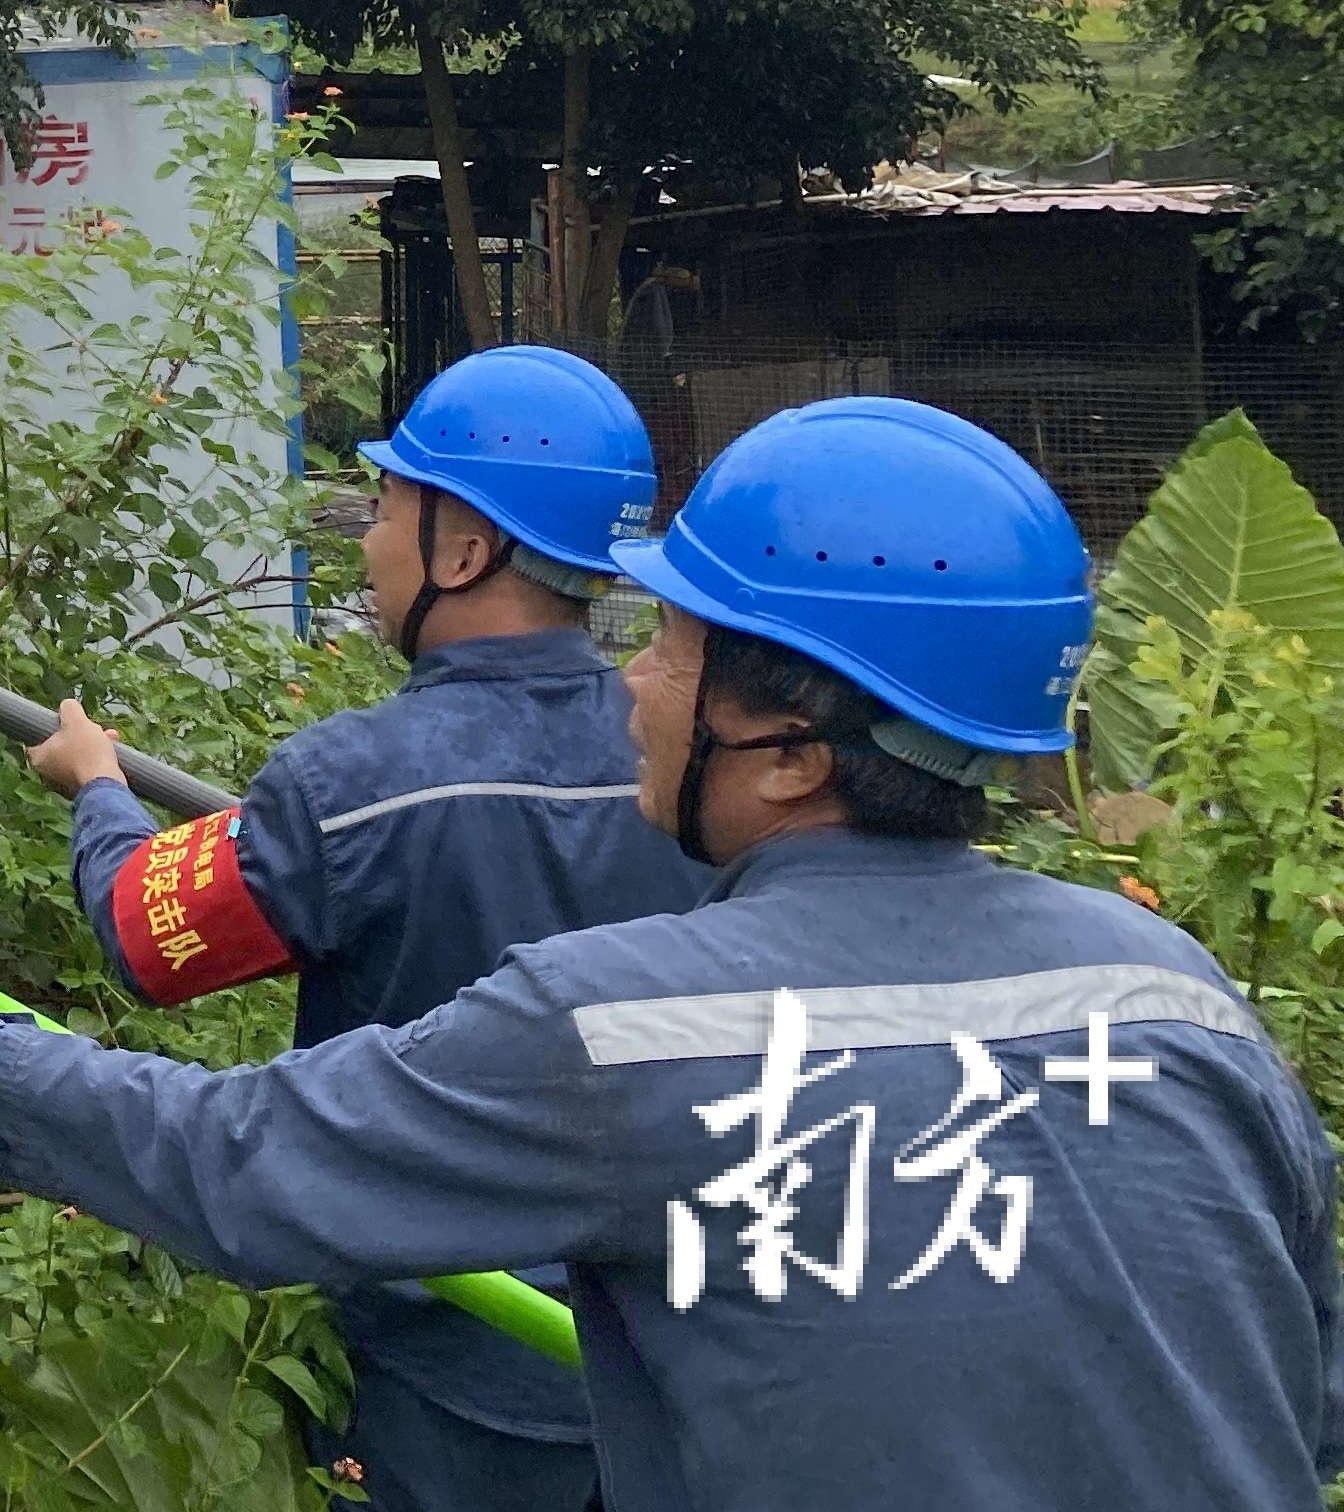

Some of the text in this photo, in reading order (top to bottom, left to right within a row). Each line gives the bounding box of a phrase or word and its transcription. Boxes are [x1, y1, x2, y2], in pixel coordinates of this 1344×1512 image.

[142, 823, 208, 970] 党员突击队
